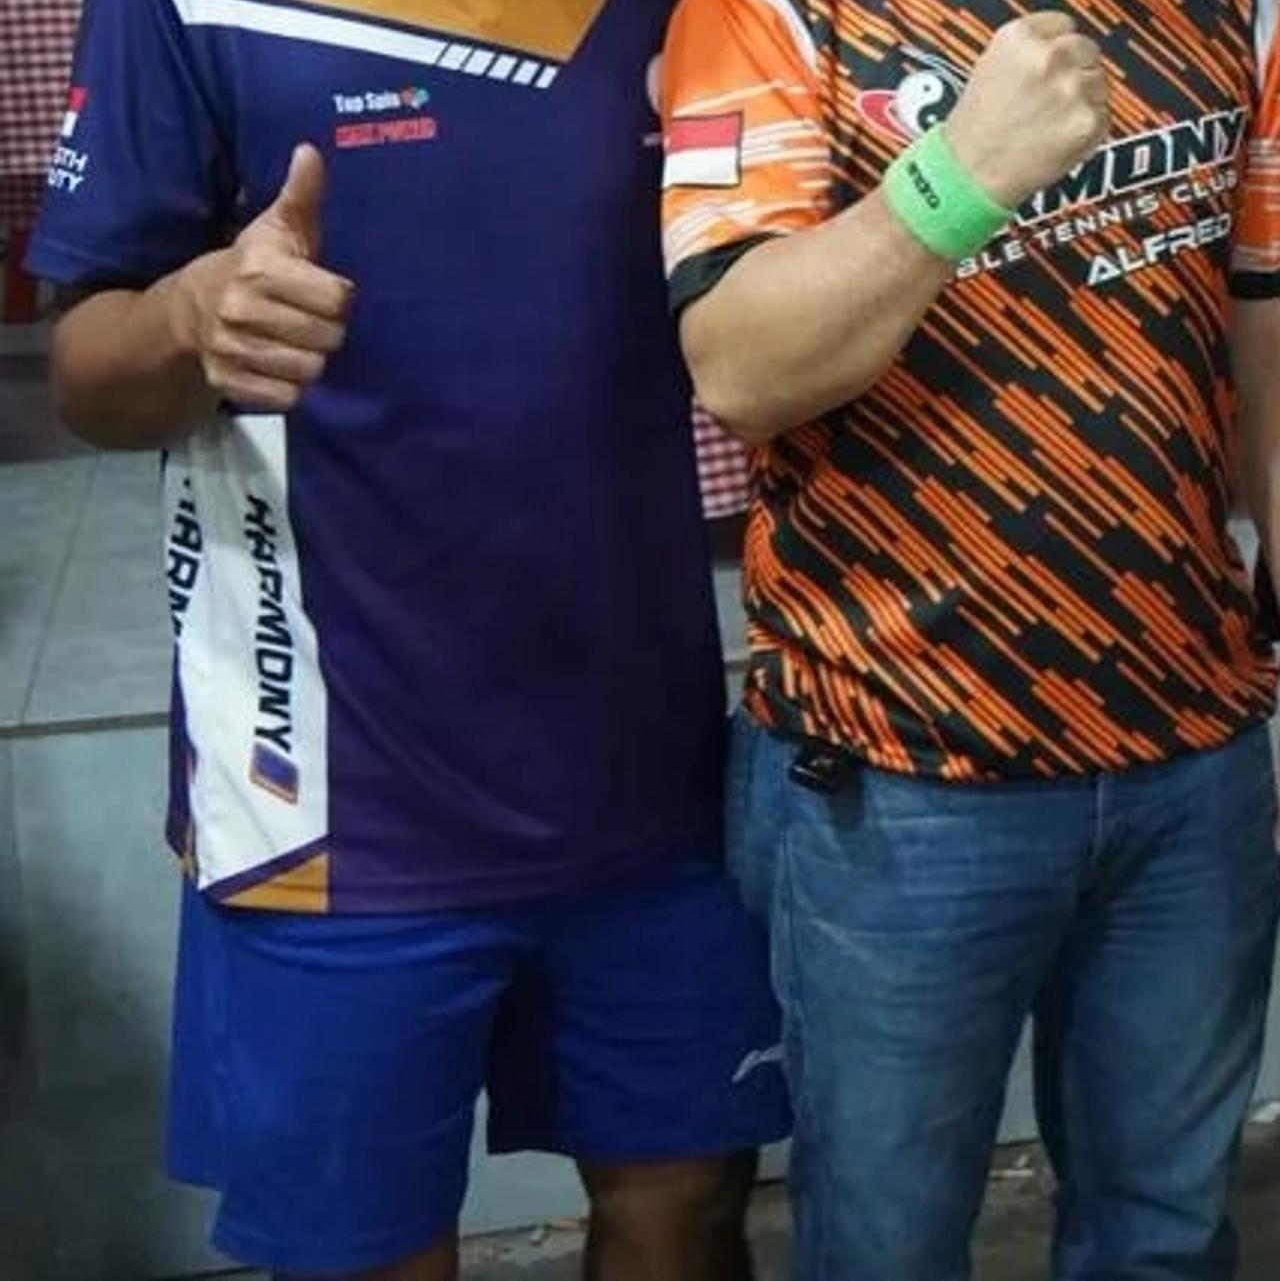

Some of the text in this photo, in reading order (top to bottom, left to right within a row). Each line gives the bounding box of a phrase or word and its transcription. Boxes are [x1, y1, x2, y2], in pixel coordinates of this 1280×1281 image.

[1013, 106, 1250, 227] MONY
[1034, 193, 1161, 252] TENNIS
[1171, 168, 1238, 204] CLUB
[1087, 212, 1233, 286] ALFRED
